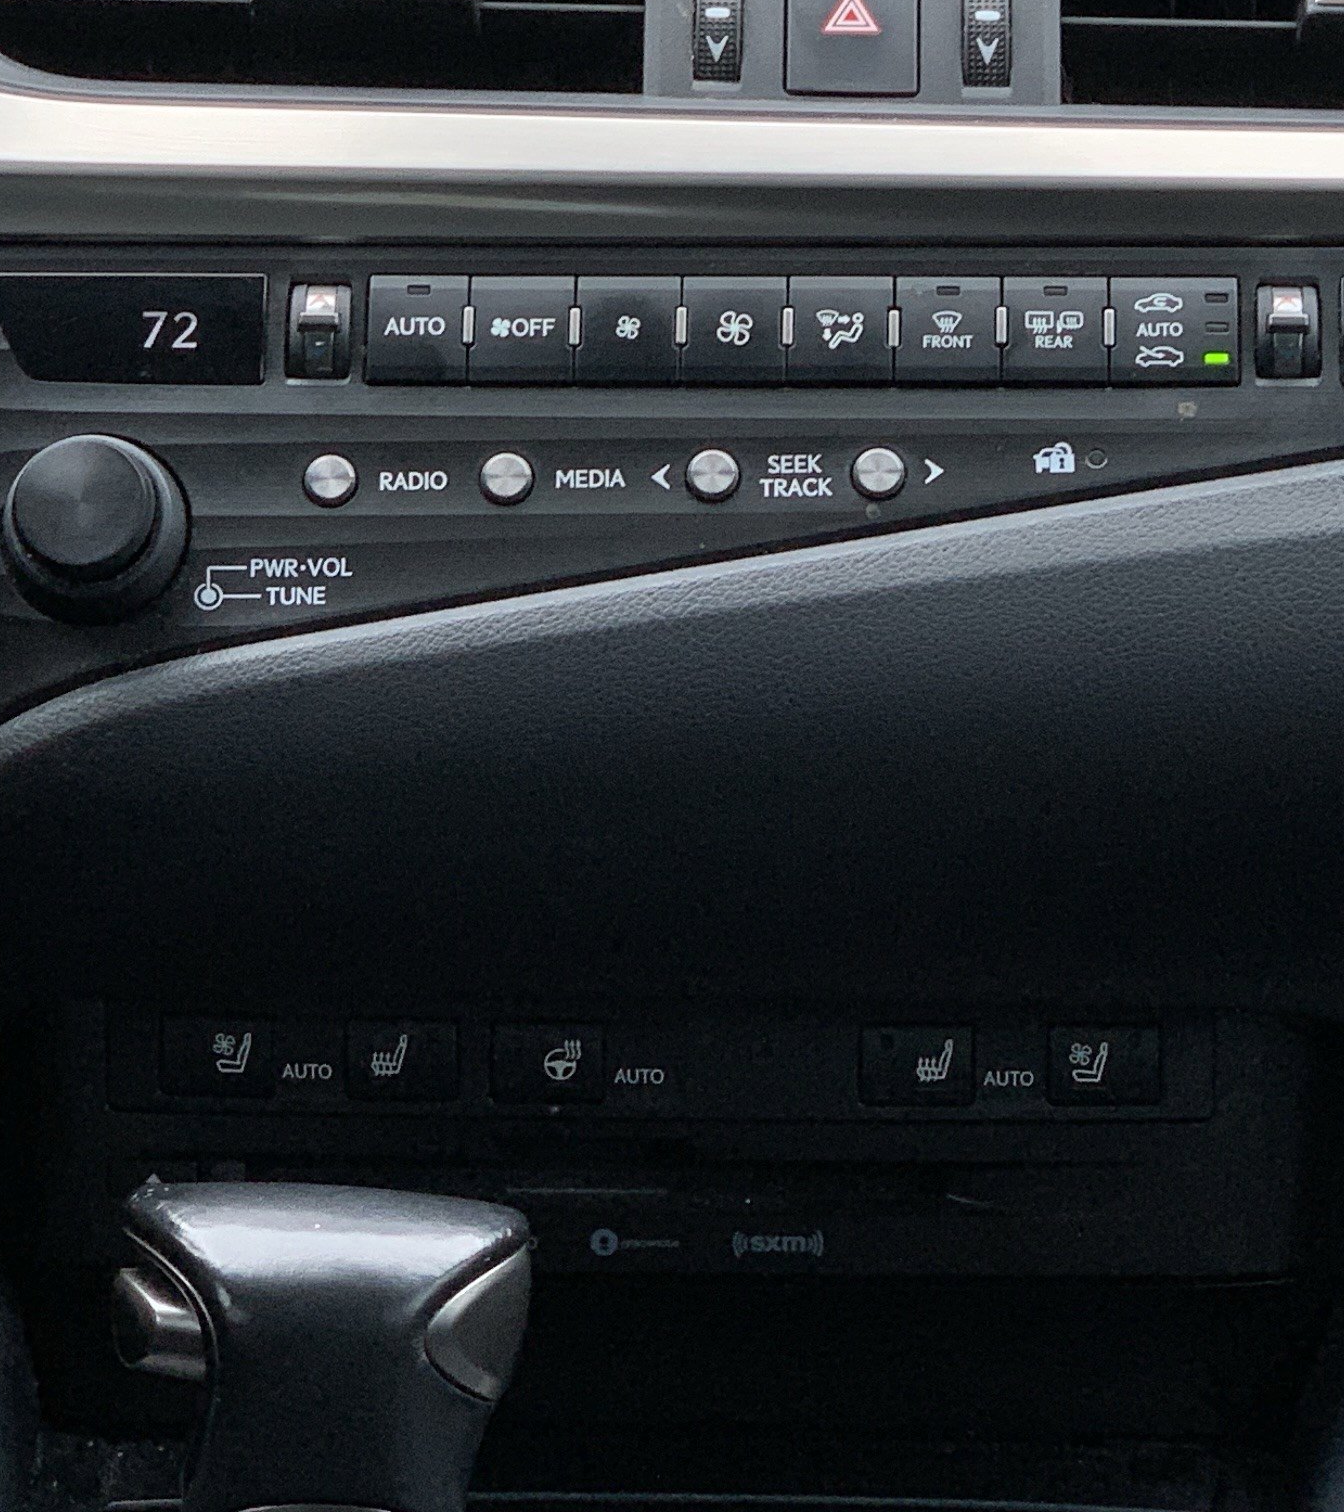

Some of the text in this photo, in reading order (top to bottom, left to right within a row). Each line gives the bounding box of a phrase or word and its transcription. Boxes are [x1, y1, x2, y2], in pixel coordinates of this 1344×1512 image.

[141, 311, 198, 350] 72
[384, 316, 445, 337] AUTO
[512, 317, 556, 337] OFF
[1136, 322, 1183, 337] AUTO
[922, 335, 973, 349] FRONT
[1035, 335, 1073, 348] REAR
[767, 455, 822, 473] SEEK
[378, 472, 448, 491] RADIO
[555, 471, 626, 490] MEDIA
[759, 477, 832, 498] TRACK
[266, 587, 326, 606] TUNE
[281, 1063, 333, 1079] AUTO
[613, 1068, 665, 1085] AUTO
[983, 1070, 1034, 1086] AUTO
